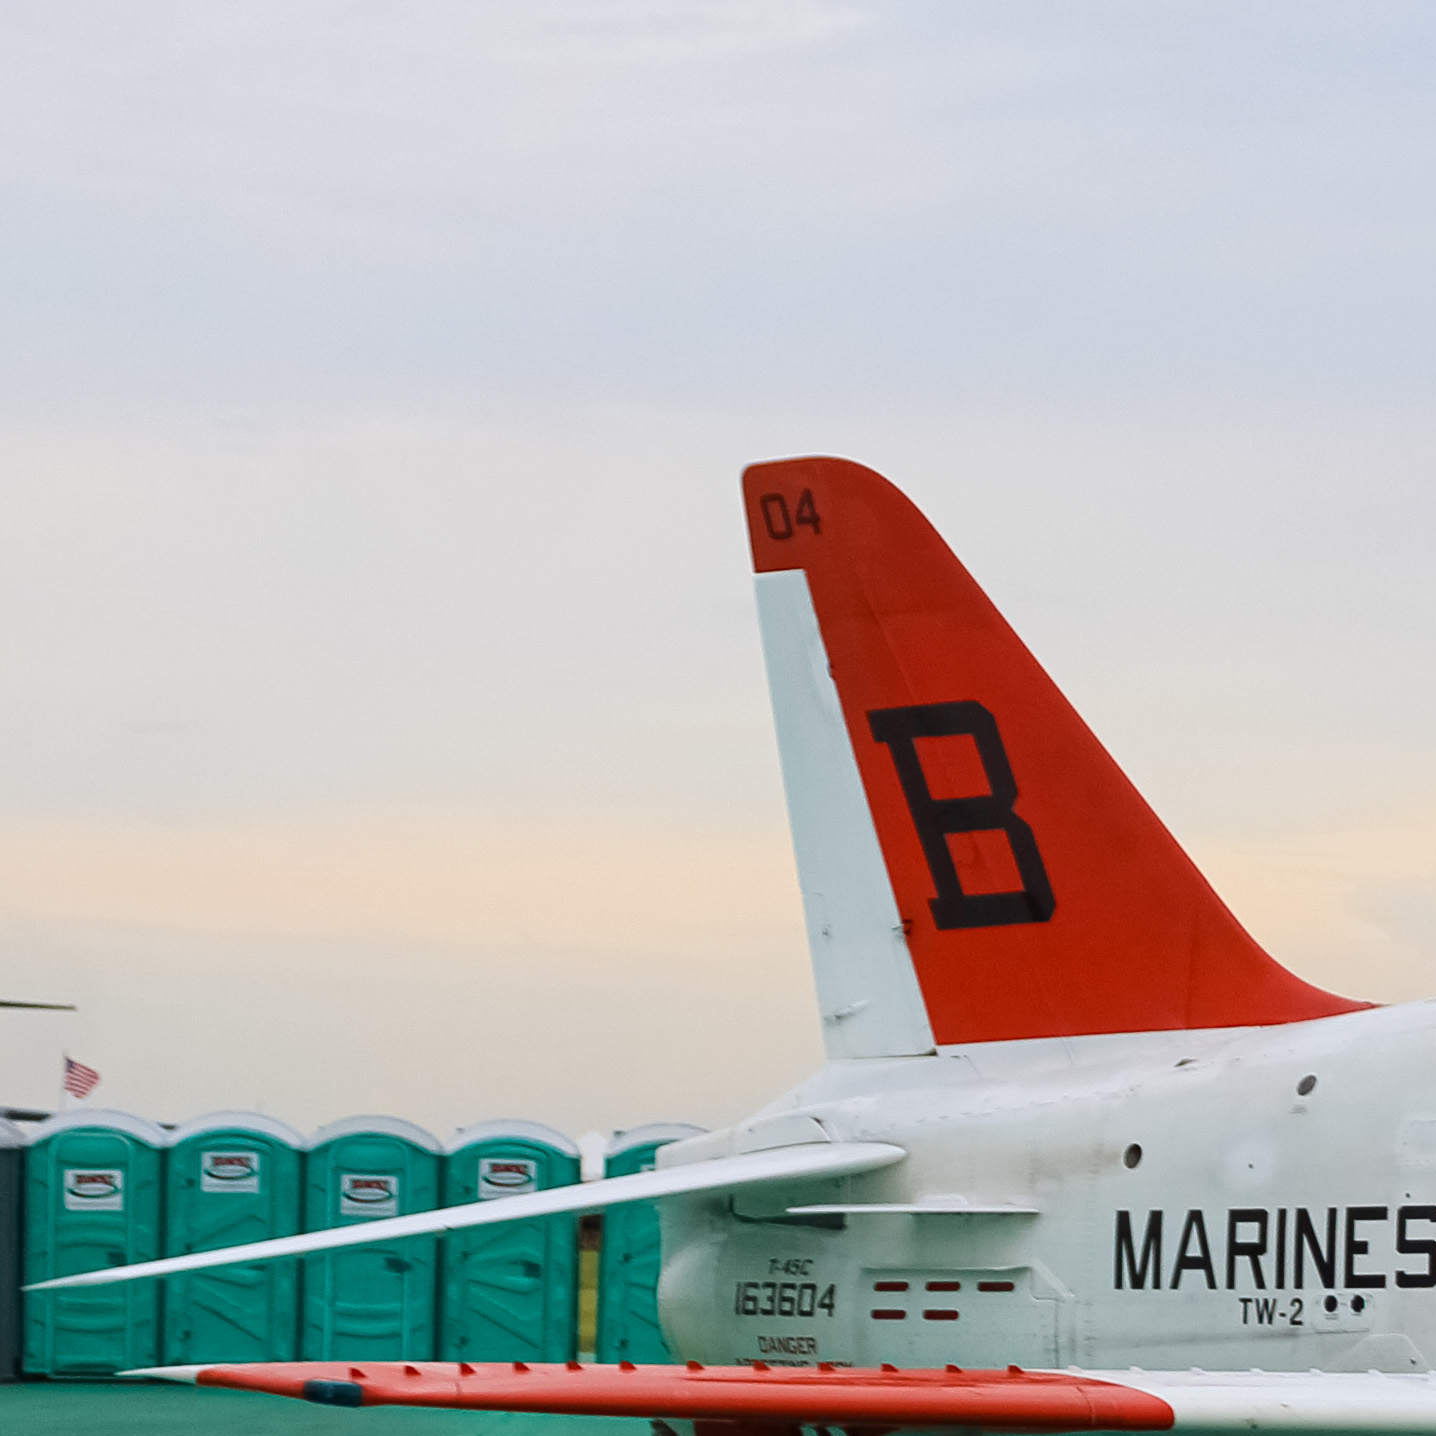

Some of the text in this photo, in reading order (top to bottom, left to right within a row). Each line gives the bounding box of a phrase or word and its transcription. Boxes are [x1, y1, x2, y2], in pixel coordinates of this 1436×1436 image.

[760, 488, 822, 541] 04
[866, 700, 1056, 930] B
[735, 1282, 836, 1317] 163604
[1239, 1298, 1303, 1326] TW-2
[758, 1335, 818, 1354] DANGER
